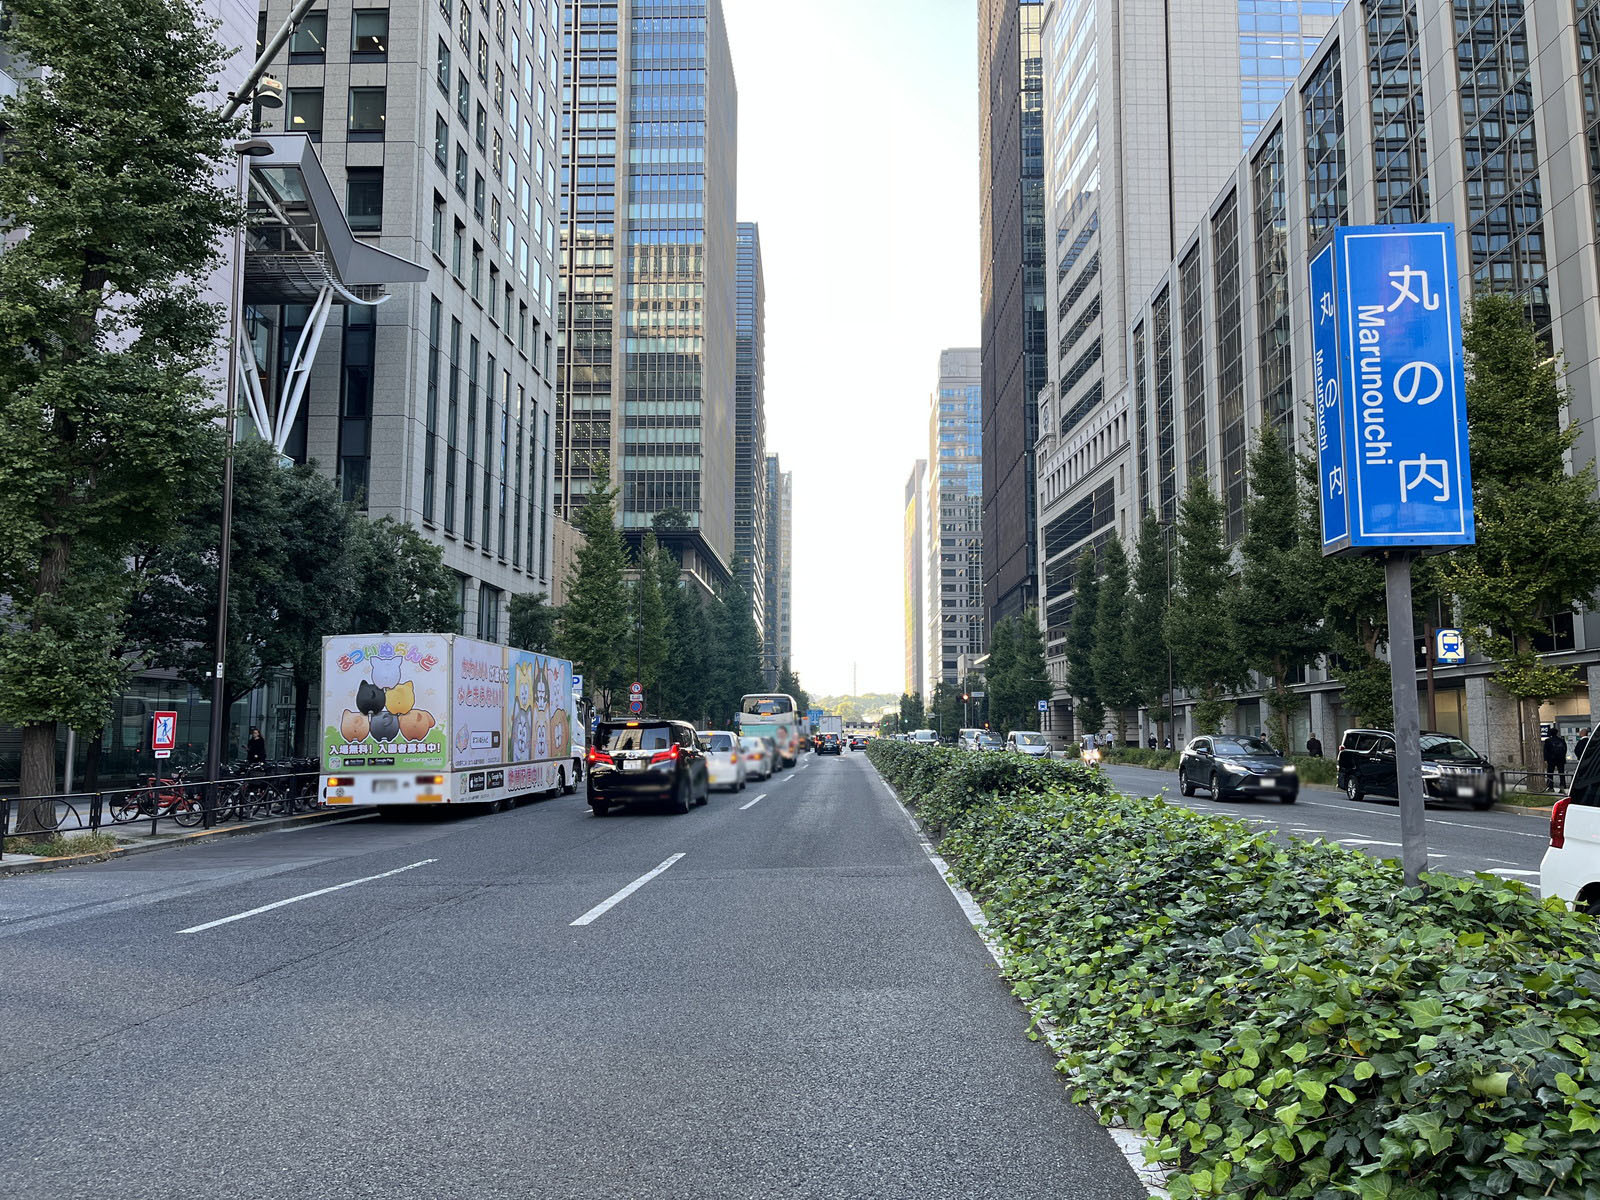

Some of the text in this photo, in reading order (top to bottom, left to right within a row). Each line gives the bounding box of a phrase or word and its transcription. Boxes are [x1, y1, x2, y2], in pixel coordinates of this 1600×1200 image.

[1315, 348, 1329, 451] Marunouchi
[1320, 291, 1343, 500] 丸の内
[1357, 305, 1394, 465] Marunouchi
[1387, 264, 1451, 503] 丸の内
[337, 643, 439, 671] まついぬらんど
